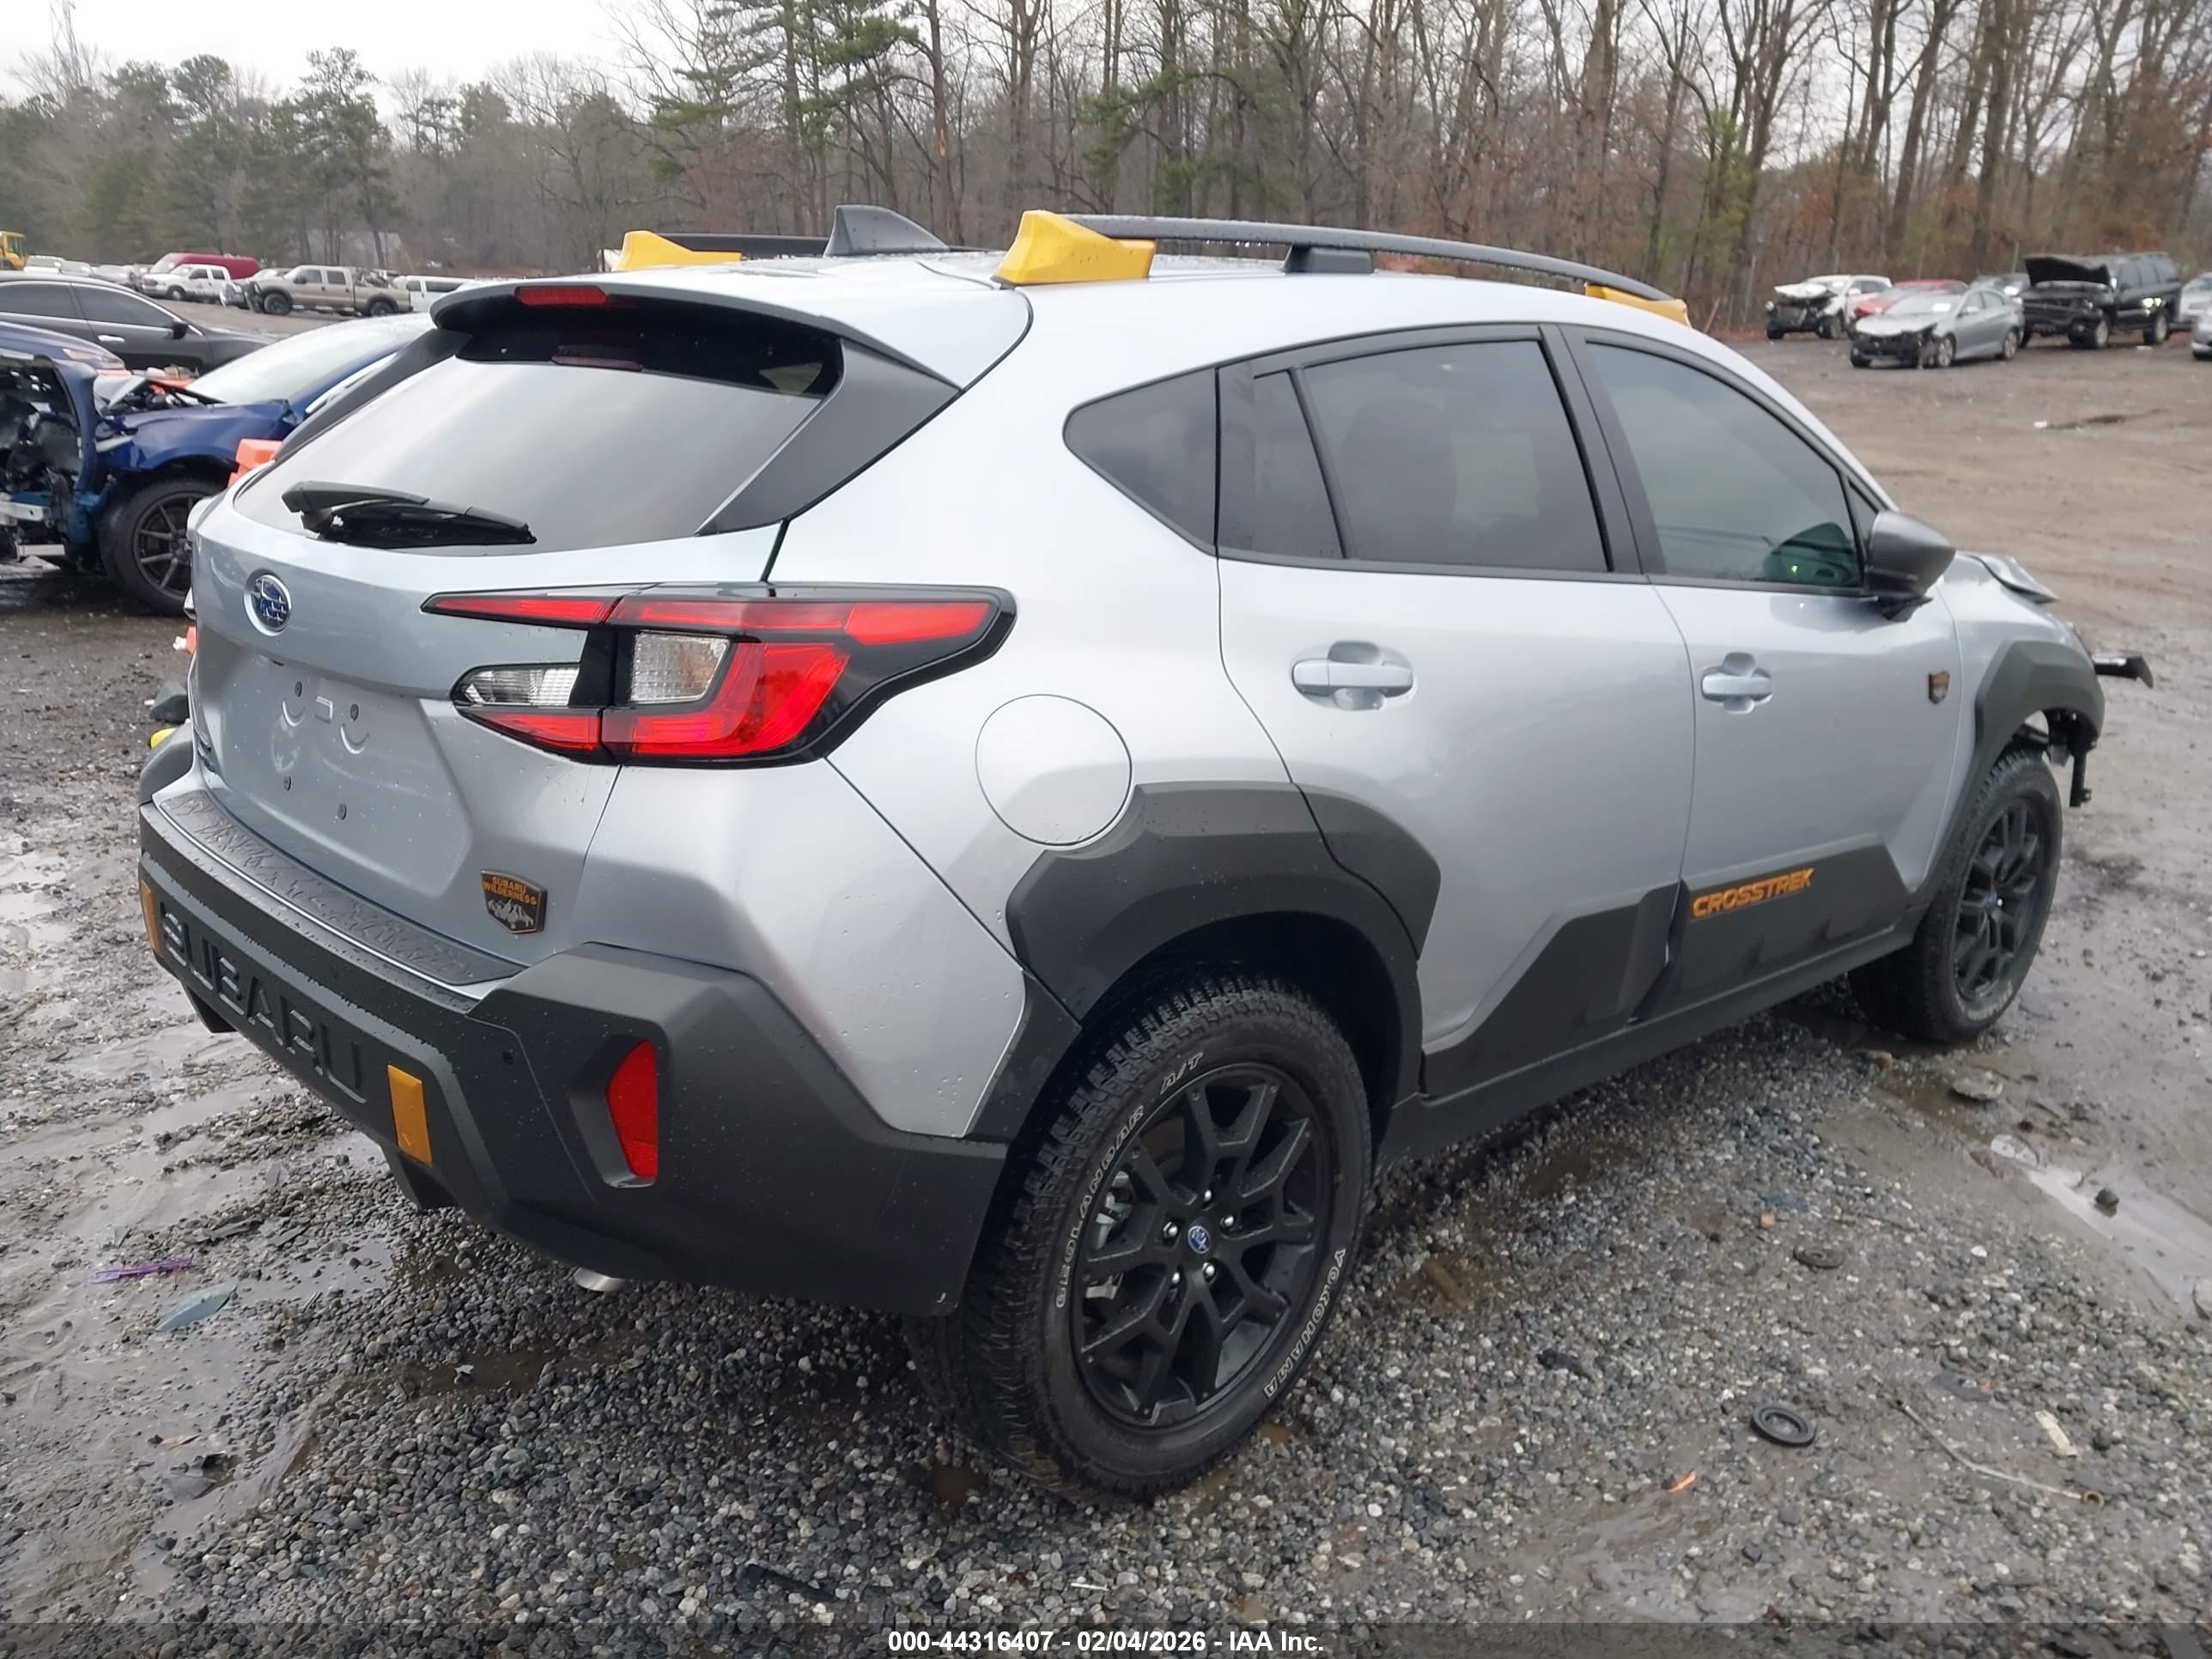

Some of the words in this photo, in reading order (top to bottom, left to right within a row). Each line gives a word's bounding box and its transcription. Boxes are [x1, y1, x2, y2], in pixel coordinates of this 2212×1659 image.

[482, 881, 537, 906] WILDERNESS
[492, 876, 526, 894] SUBARU
[1692, 868, 1814, 917] CROSSTREK
[160, 902, 367, 1104] SUBARU
[1055, 1104, 1145, 1309] GEOLANDAR
[1159, 1052, 1204, 1095] A/T
[1263, 1248, 1347, 1399] YOKOHAMA
